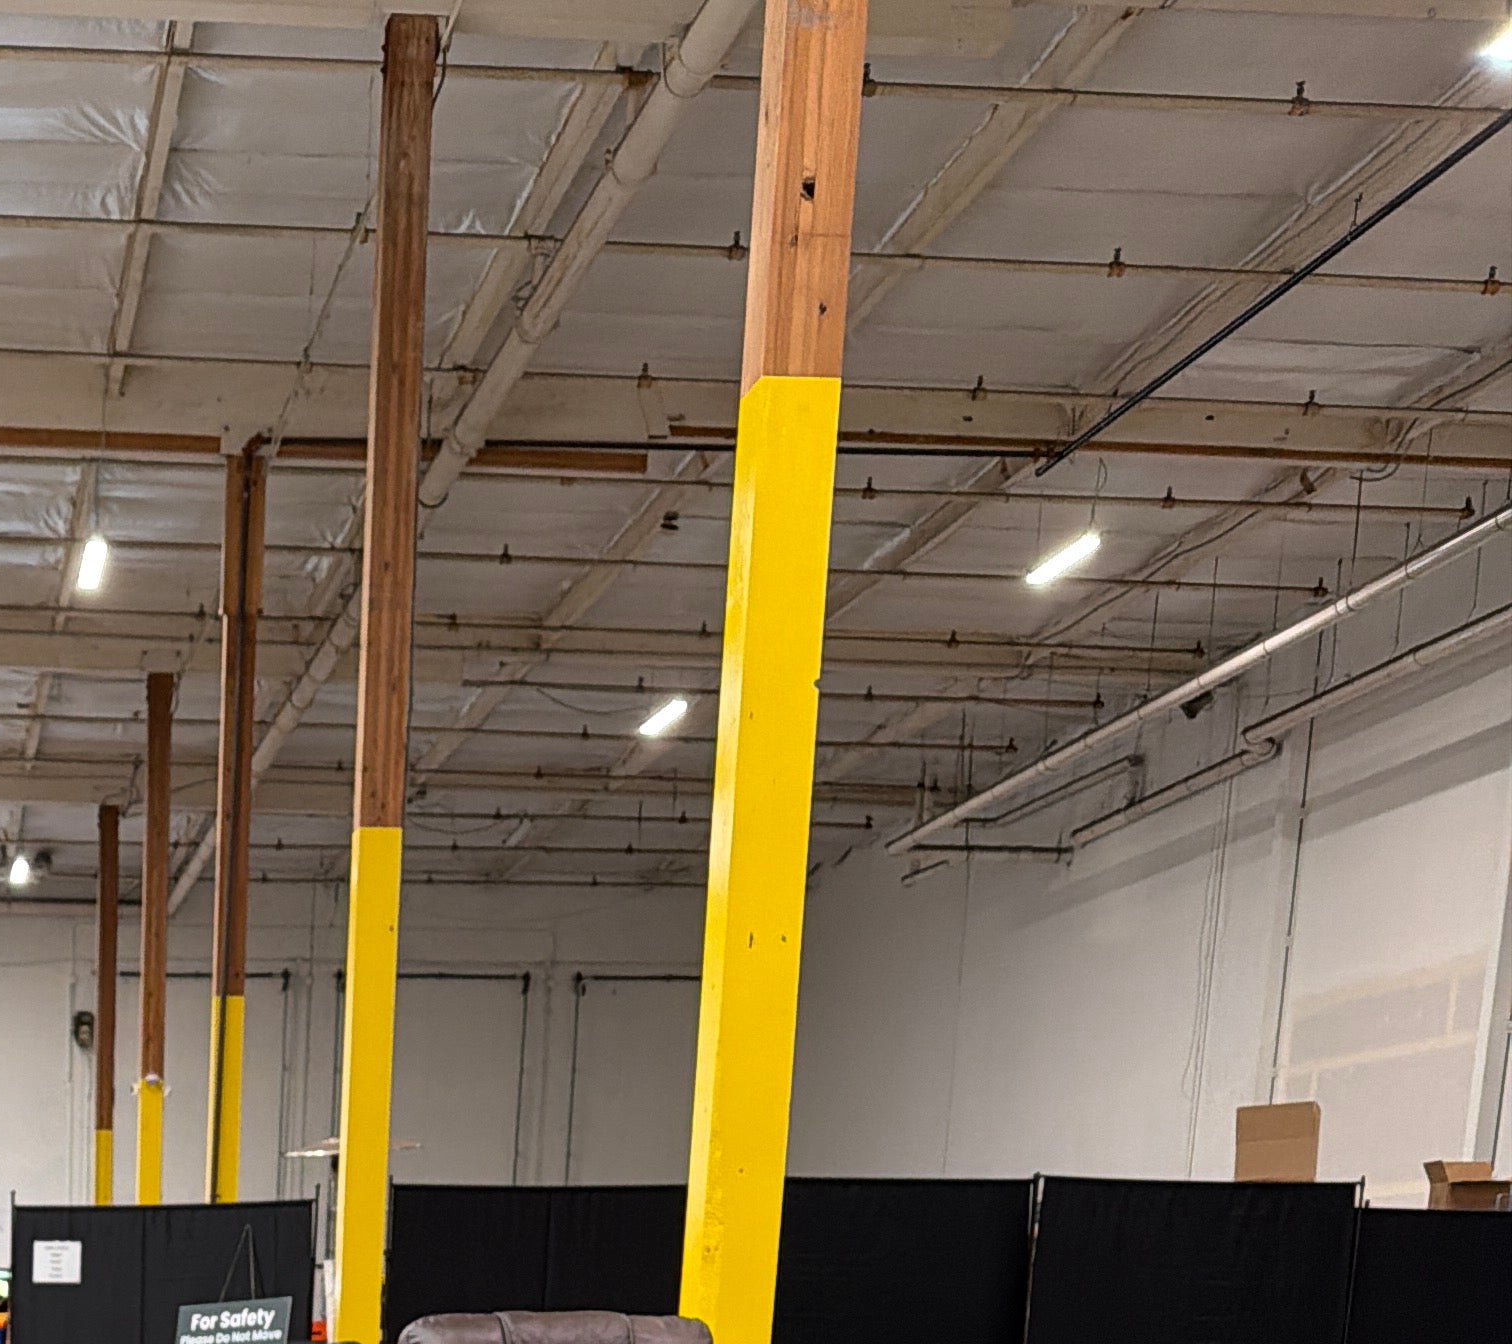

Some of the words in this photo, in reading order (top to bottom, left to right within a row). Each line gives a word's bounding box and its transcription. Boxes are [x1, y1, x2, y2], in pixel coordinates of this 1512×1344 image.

[190, 1313, 218, 1331] For
[220, 1307, 275, 1330] Safety
[215, 1332, 230, 1344] Do
[231, 1330, 251, 1343] Not
[251, 1329, 282, 1342] Move
